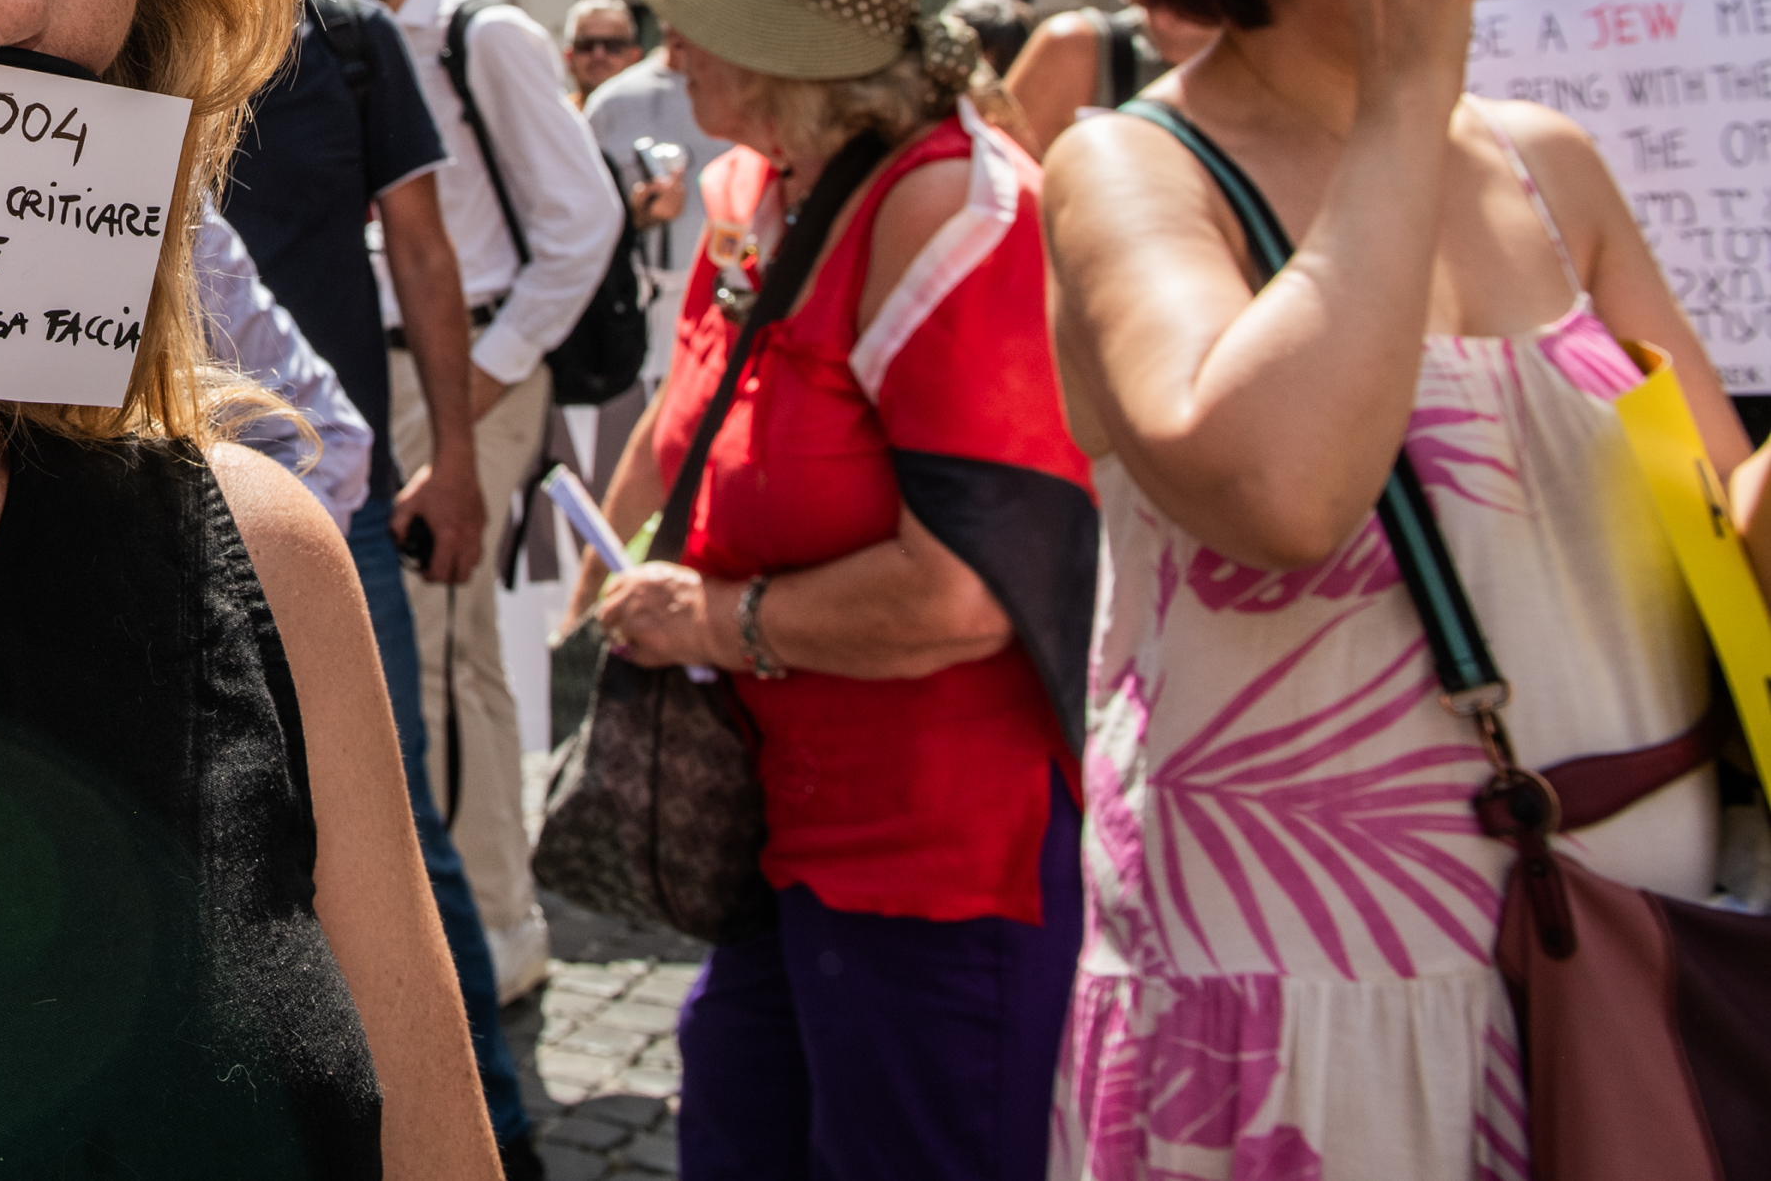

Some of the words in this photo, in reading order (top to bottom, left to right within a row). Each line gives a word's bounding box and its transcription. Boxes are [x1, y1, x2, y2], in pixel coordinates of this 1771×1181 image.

[1535, 11, 1569, 55] A
[1581, 0, 1686, 51] JEW
[1619, 66, 1708, 109] WITH
[1619, 125, 1697, 175] THE
[5, 181, 162, 239] CRITICARE
[43, 305, 141, 353] FACCIA
